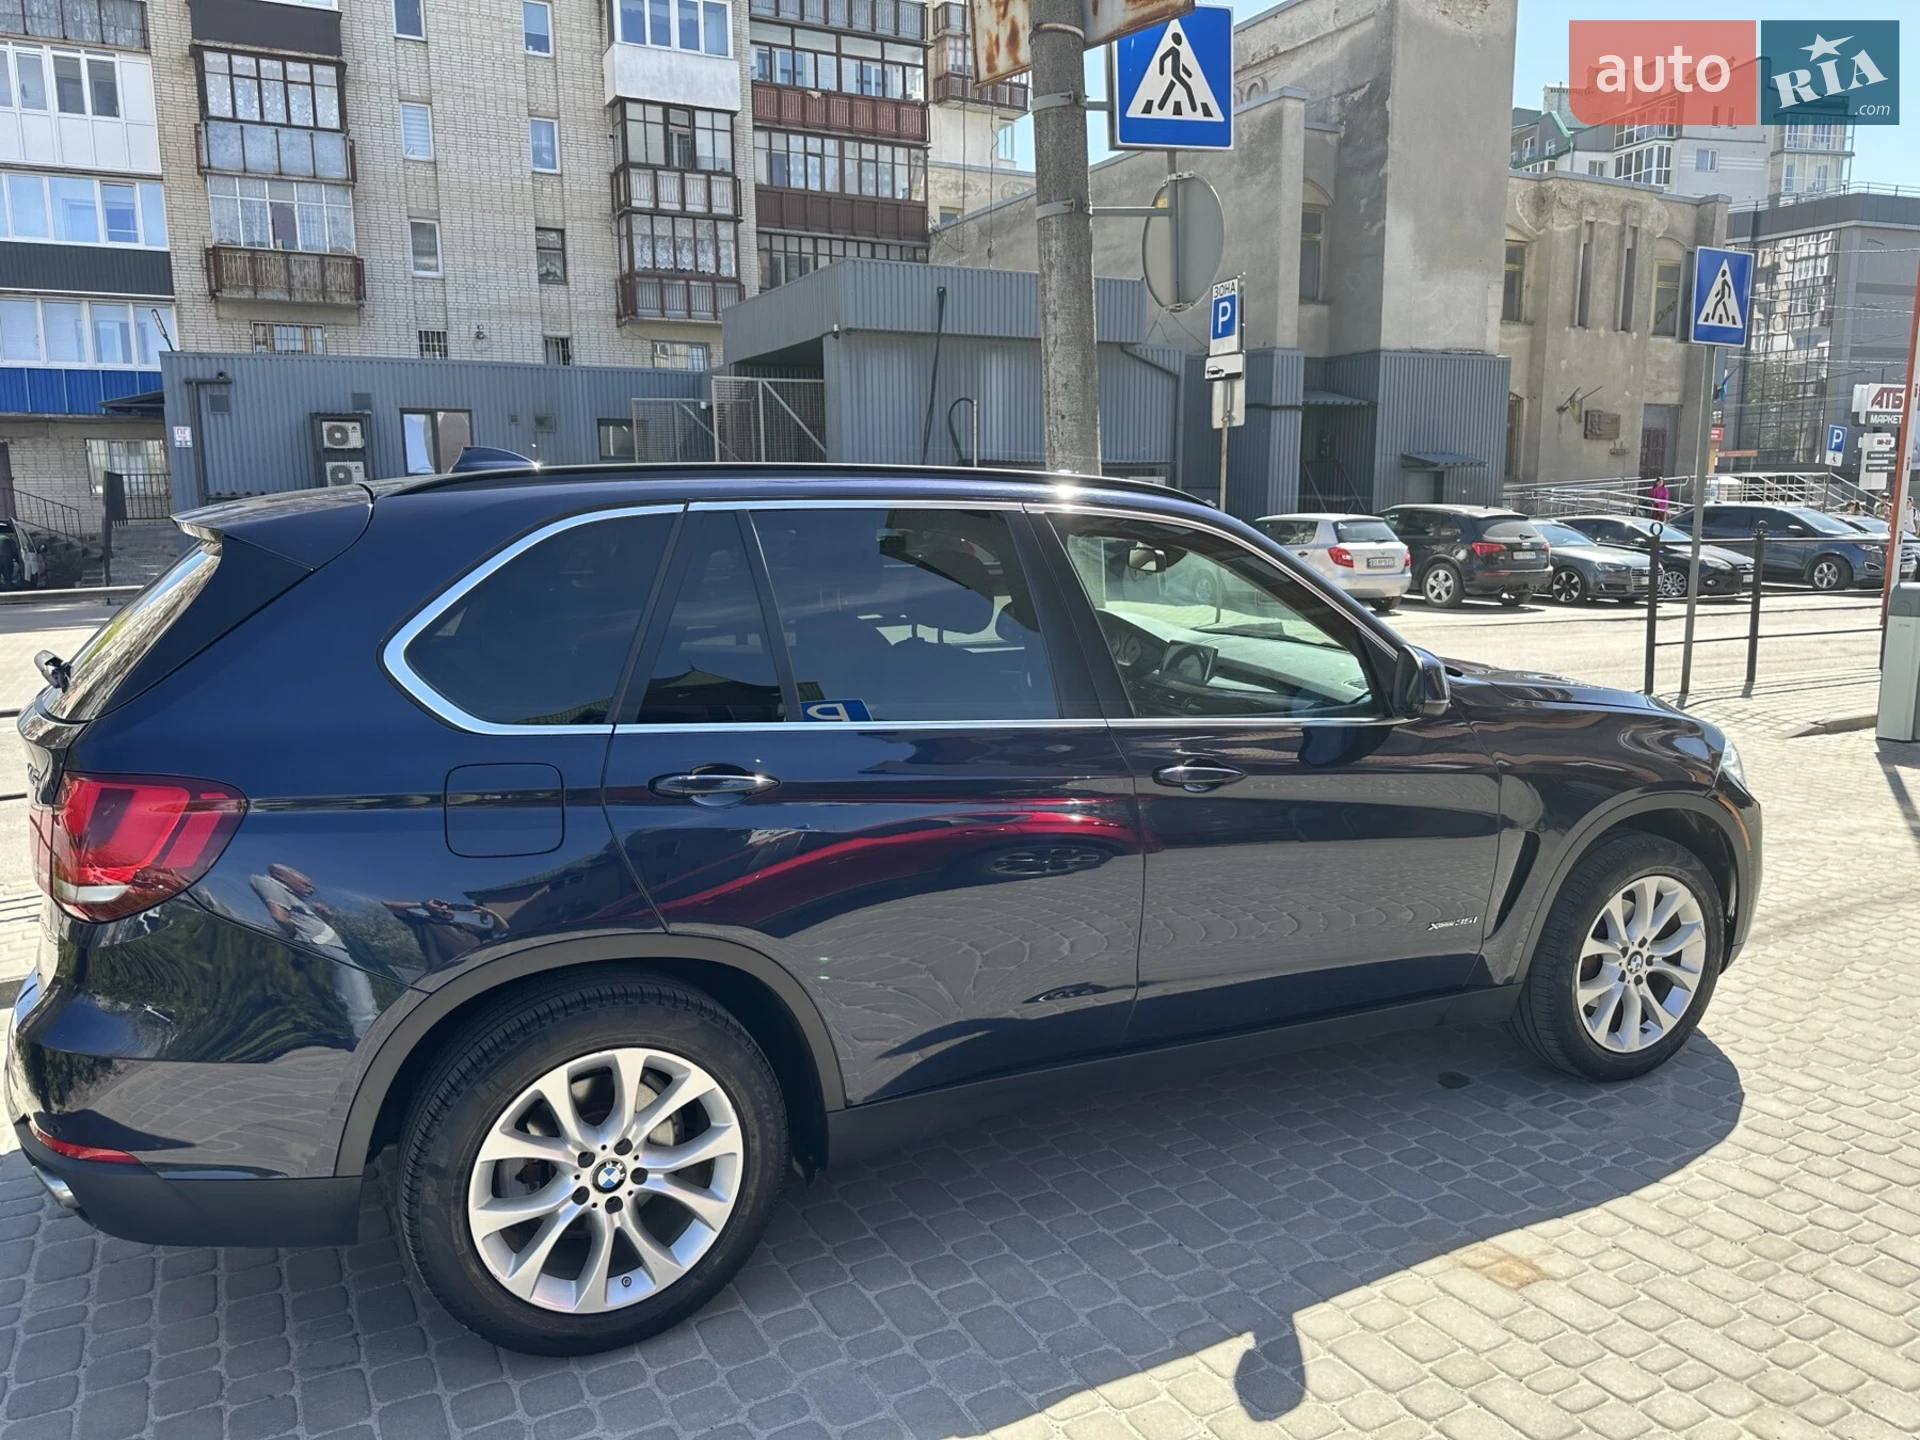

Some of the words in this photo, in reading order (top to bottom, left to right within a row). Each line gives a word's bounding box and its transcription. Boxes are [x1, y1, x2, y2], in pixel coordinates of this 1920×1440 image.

[1213, 281, 1236, 299] ЗОНА
[1217, 301, 1232, 334] P
[1871, 386, 1905, 409] АТБ
[1870, 414, 1903, 424] МАРКЕТ
[1831, 429, 1843, 449] P
